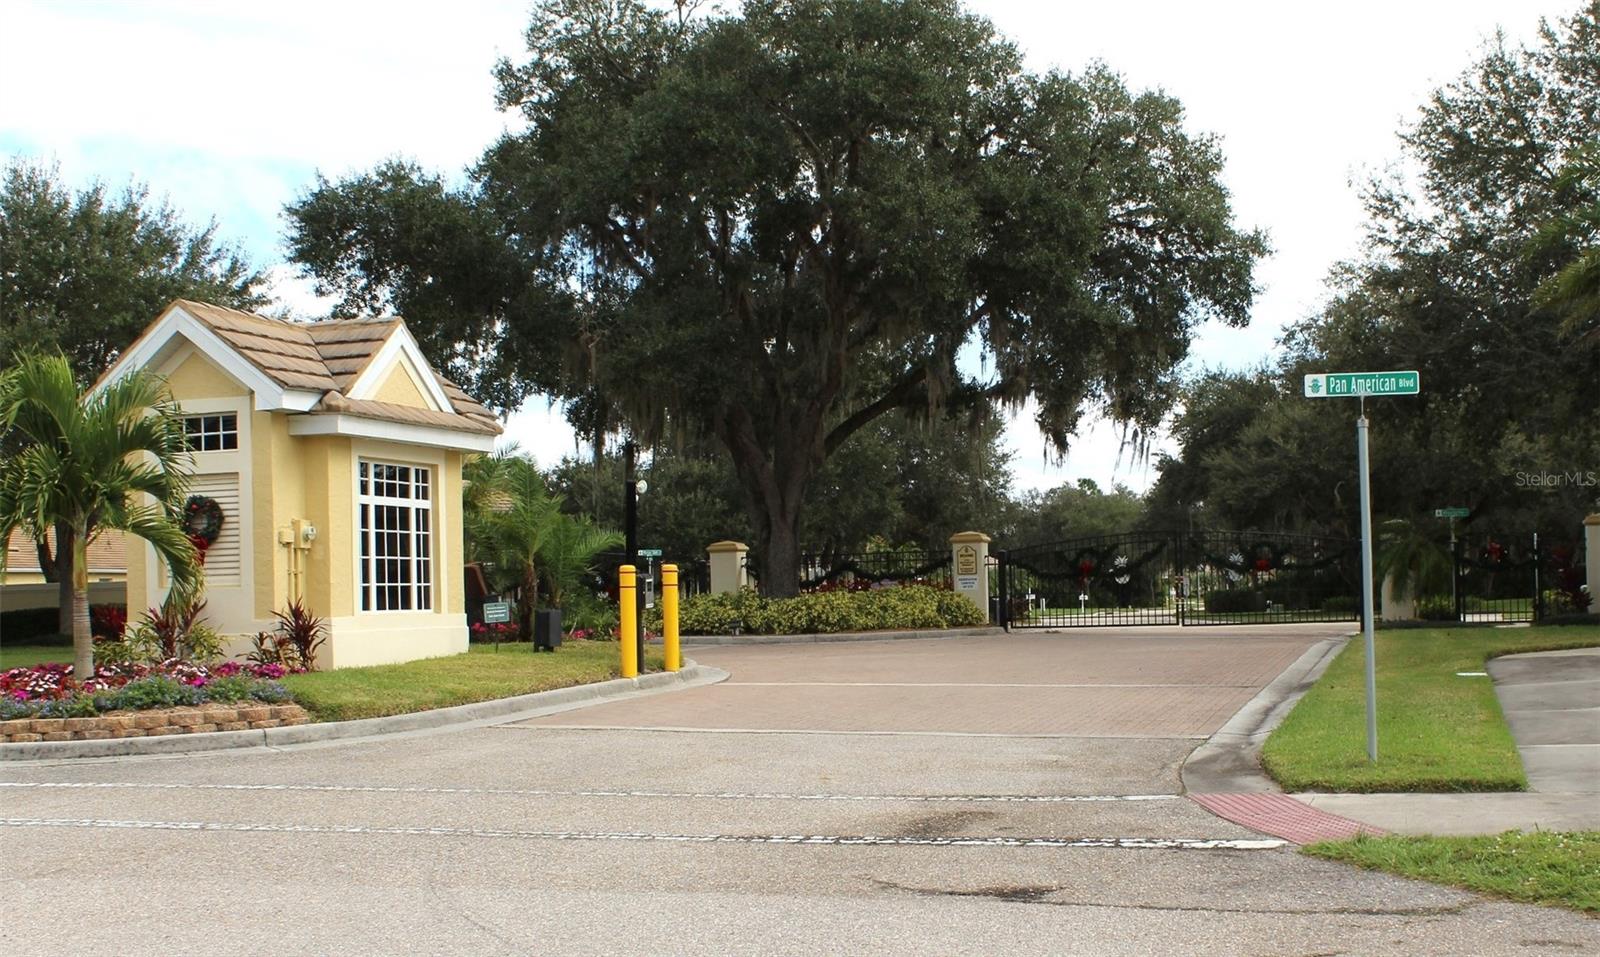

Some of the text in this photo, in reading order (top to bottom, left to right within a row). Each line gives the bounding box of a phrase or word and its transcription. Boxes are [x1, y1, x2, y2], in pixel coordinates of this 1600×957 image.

[1329, 374, 1414, 393] Pan American Blvd
